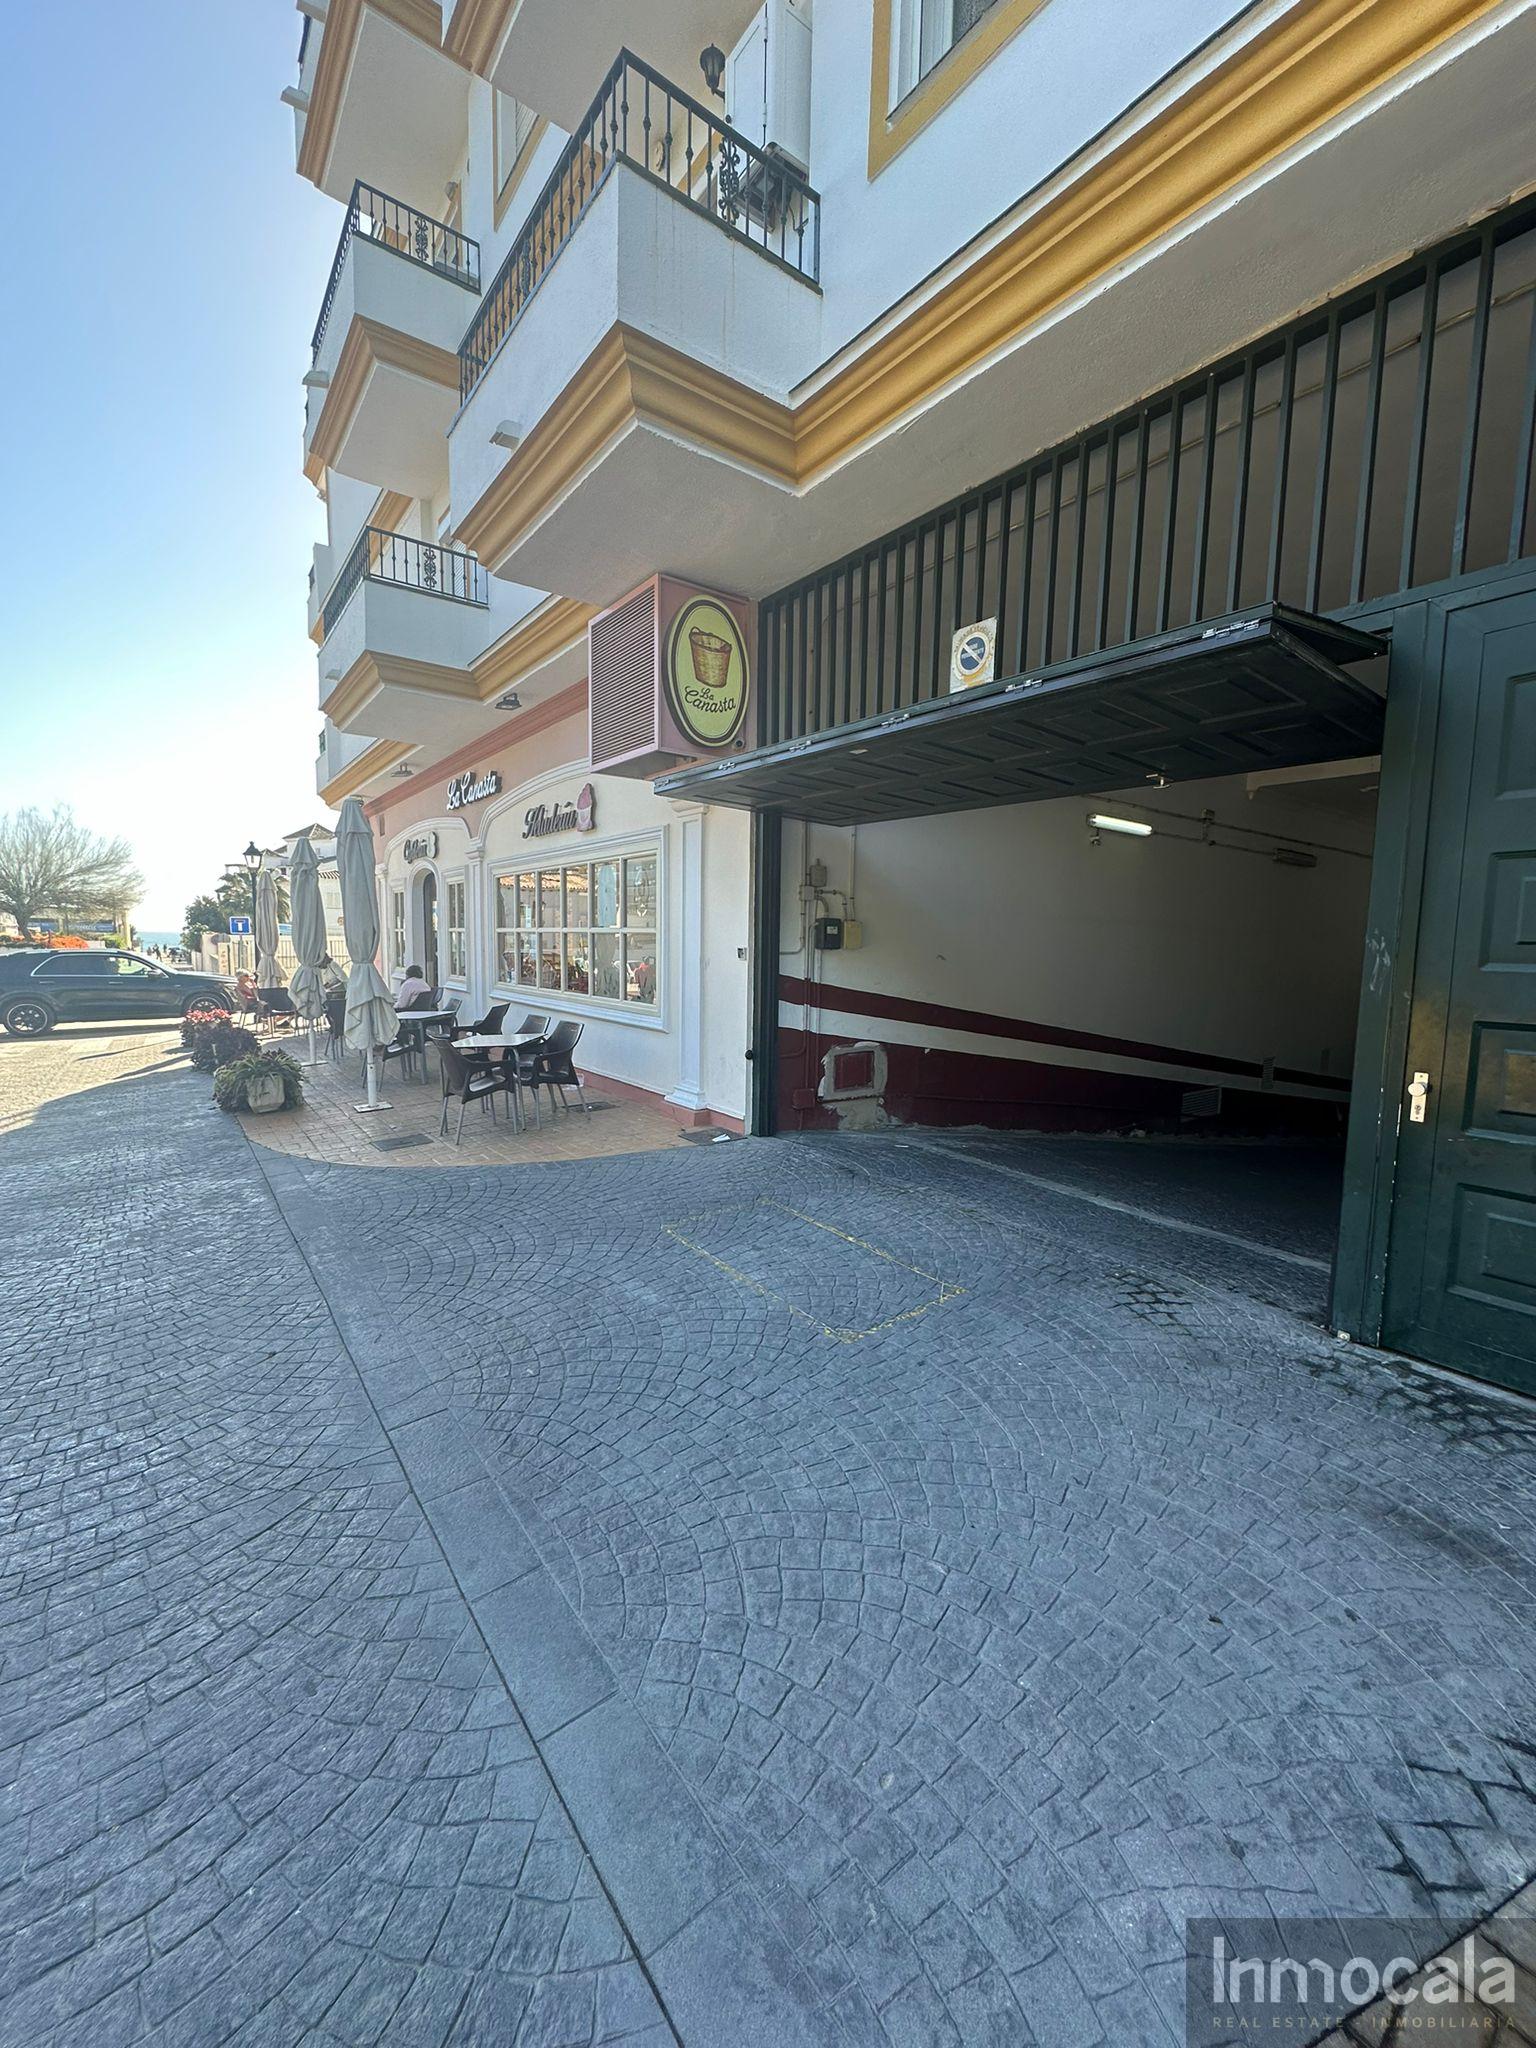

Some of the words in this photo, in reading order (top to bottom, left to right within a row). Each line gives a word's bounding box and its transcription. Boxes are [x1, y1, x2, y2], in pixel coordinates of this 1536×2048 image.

[685, 686, 736, 713] Canasta
[700, 688, 714, 701] La
[446, 779, 460, 811] La
[460, 770, 499, 805] Canasta
